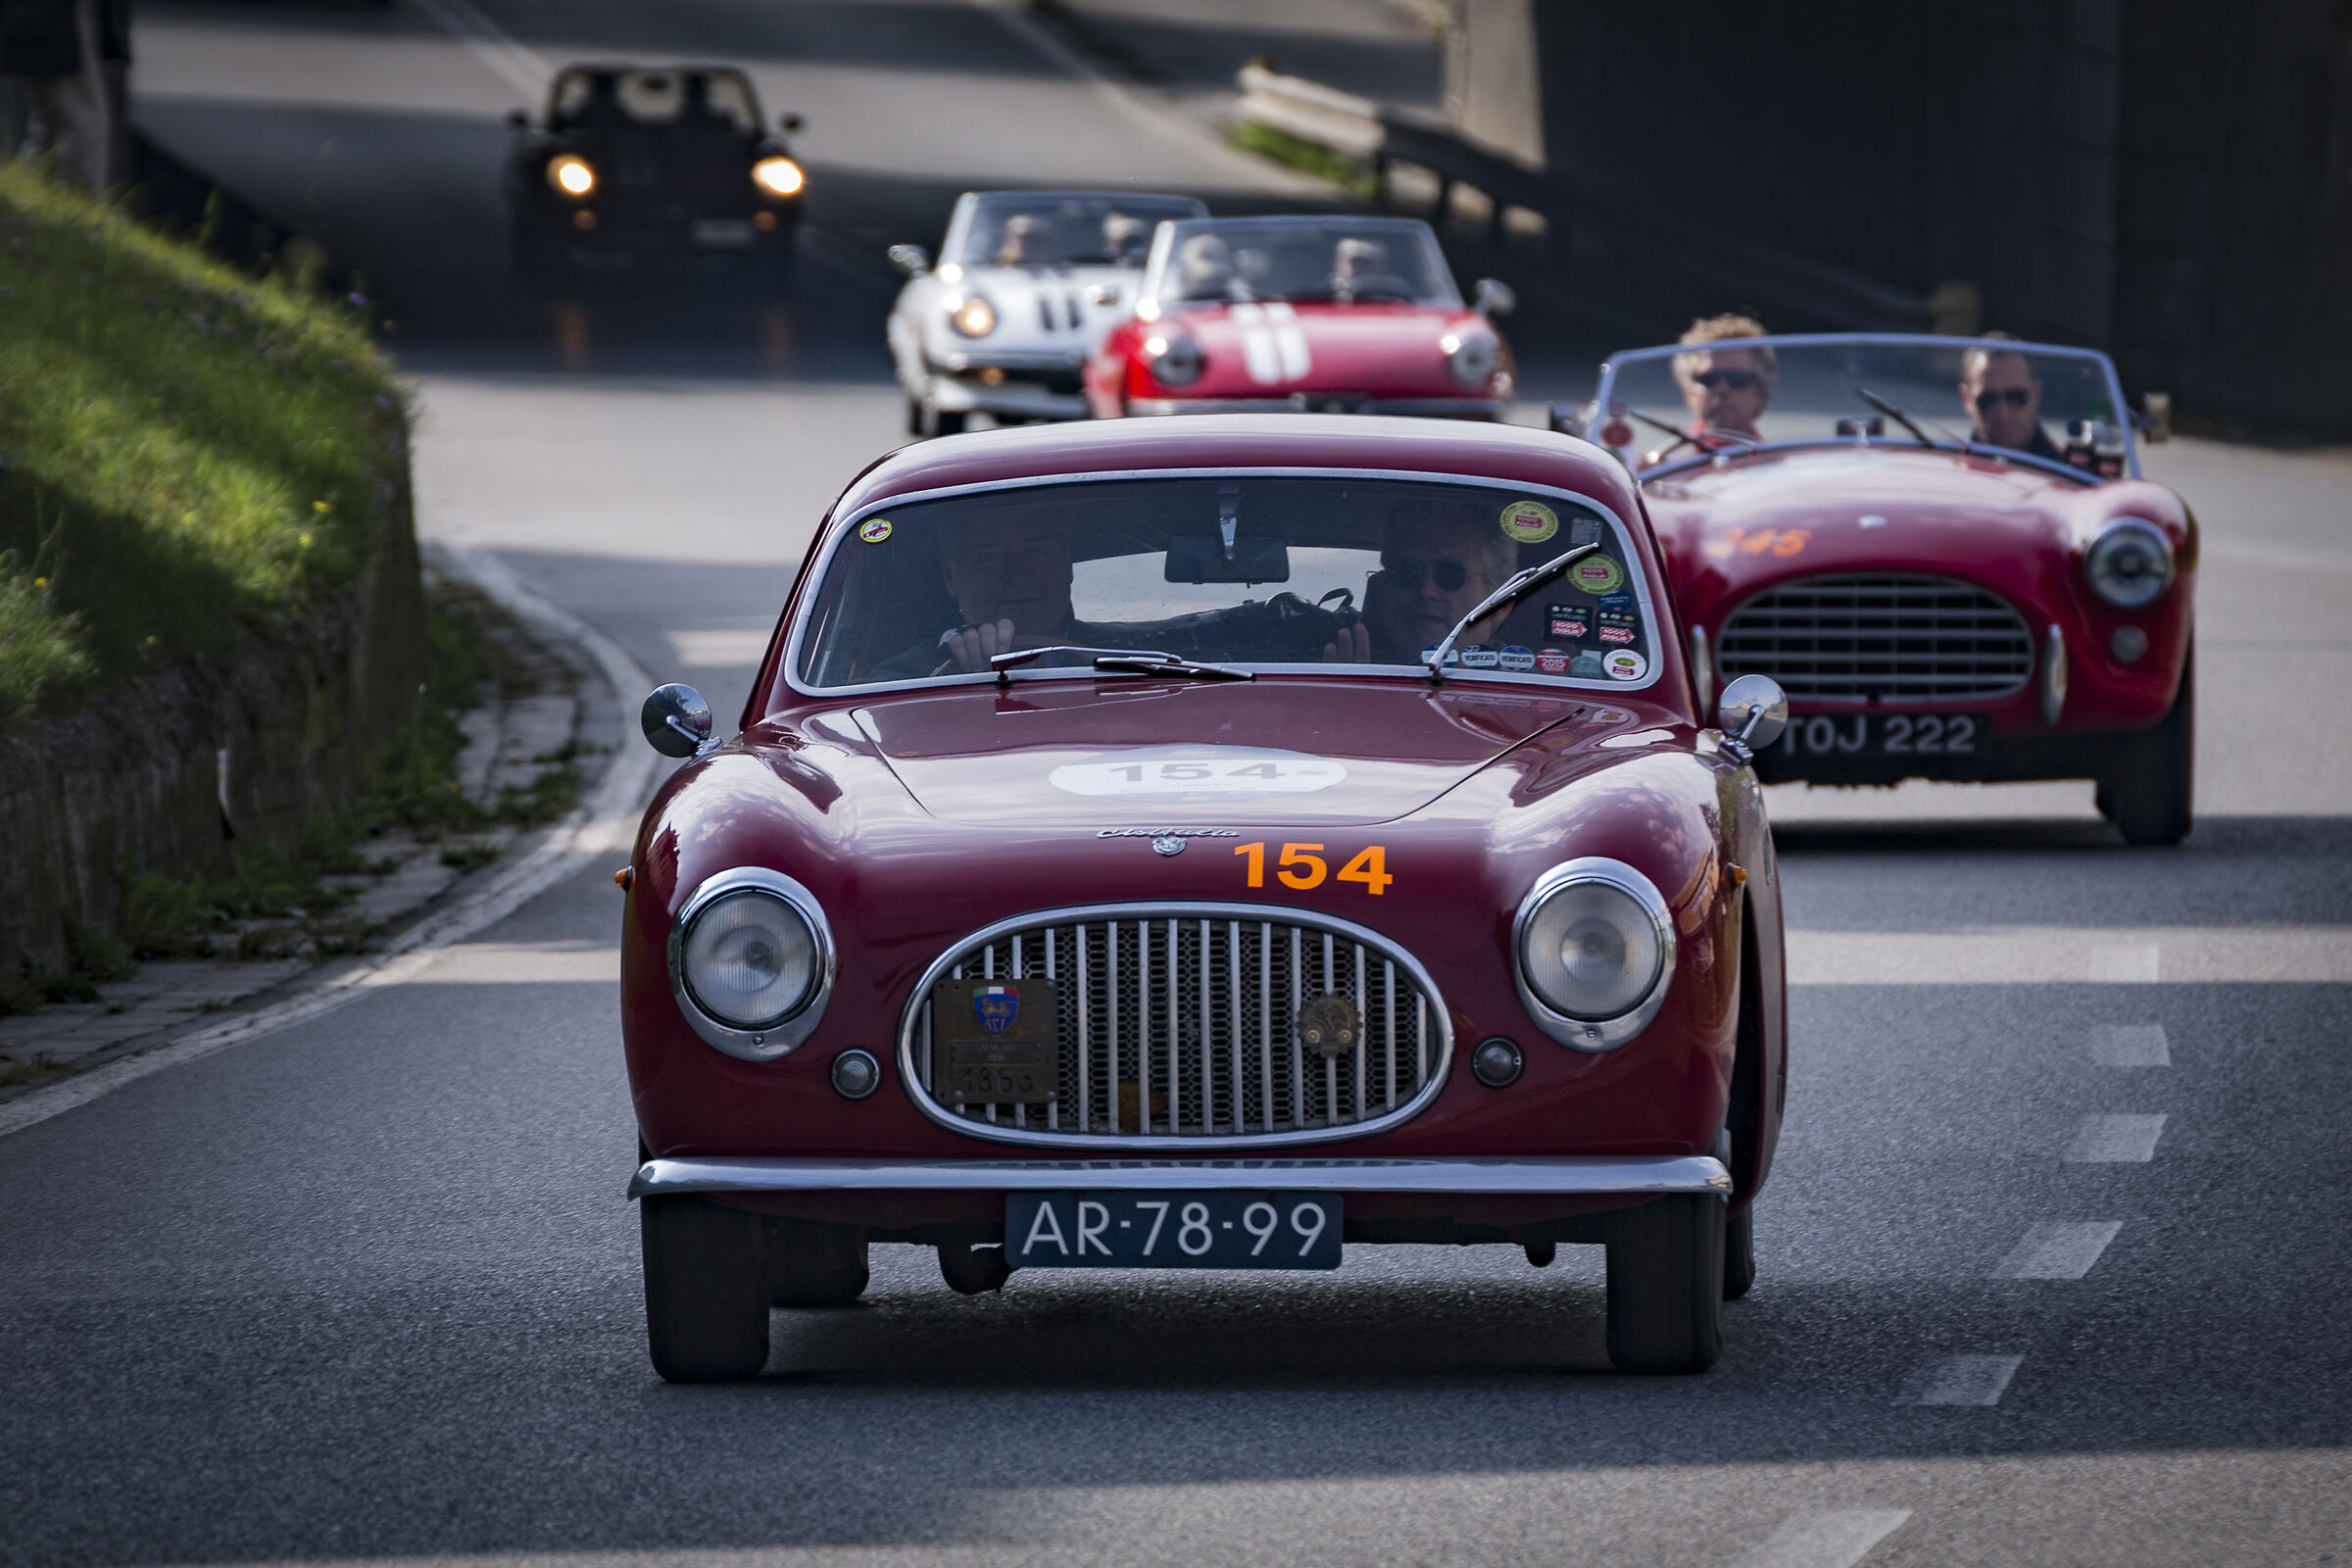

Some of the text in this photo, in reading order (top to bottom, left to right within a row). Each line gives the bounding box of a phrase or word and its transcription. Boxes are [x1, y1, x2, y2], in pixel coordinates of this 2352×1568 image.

[1541, 659, 1566, 668] 2015
[1884, 715, 1976, 754] 222
[1110, 763, 1286, 782] 154
[1234, 842, 1394, 895] 154
[964, 1066, 1033, 1093] 1363
[1021, 1200, 1327, 1257] AR-78-99
